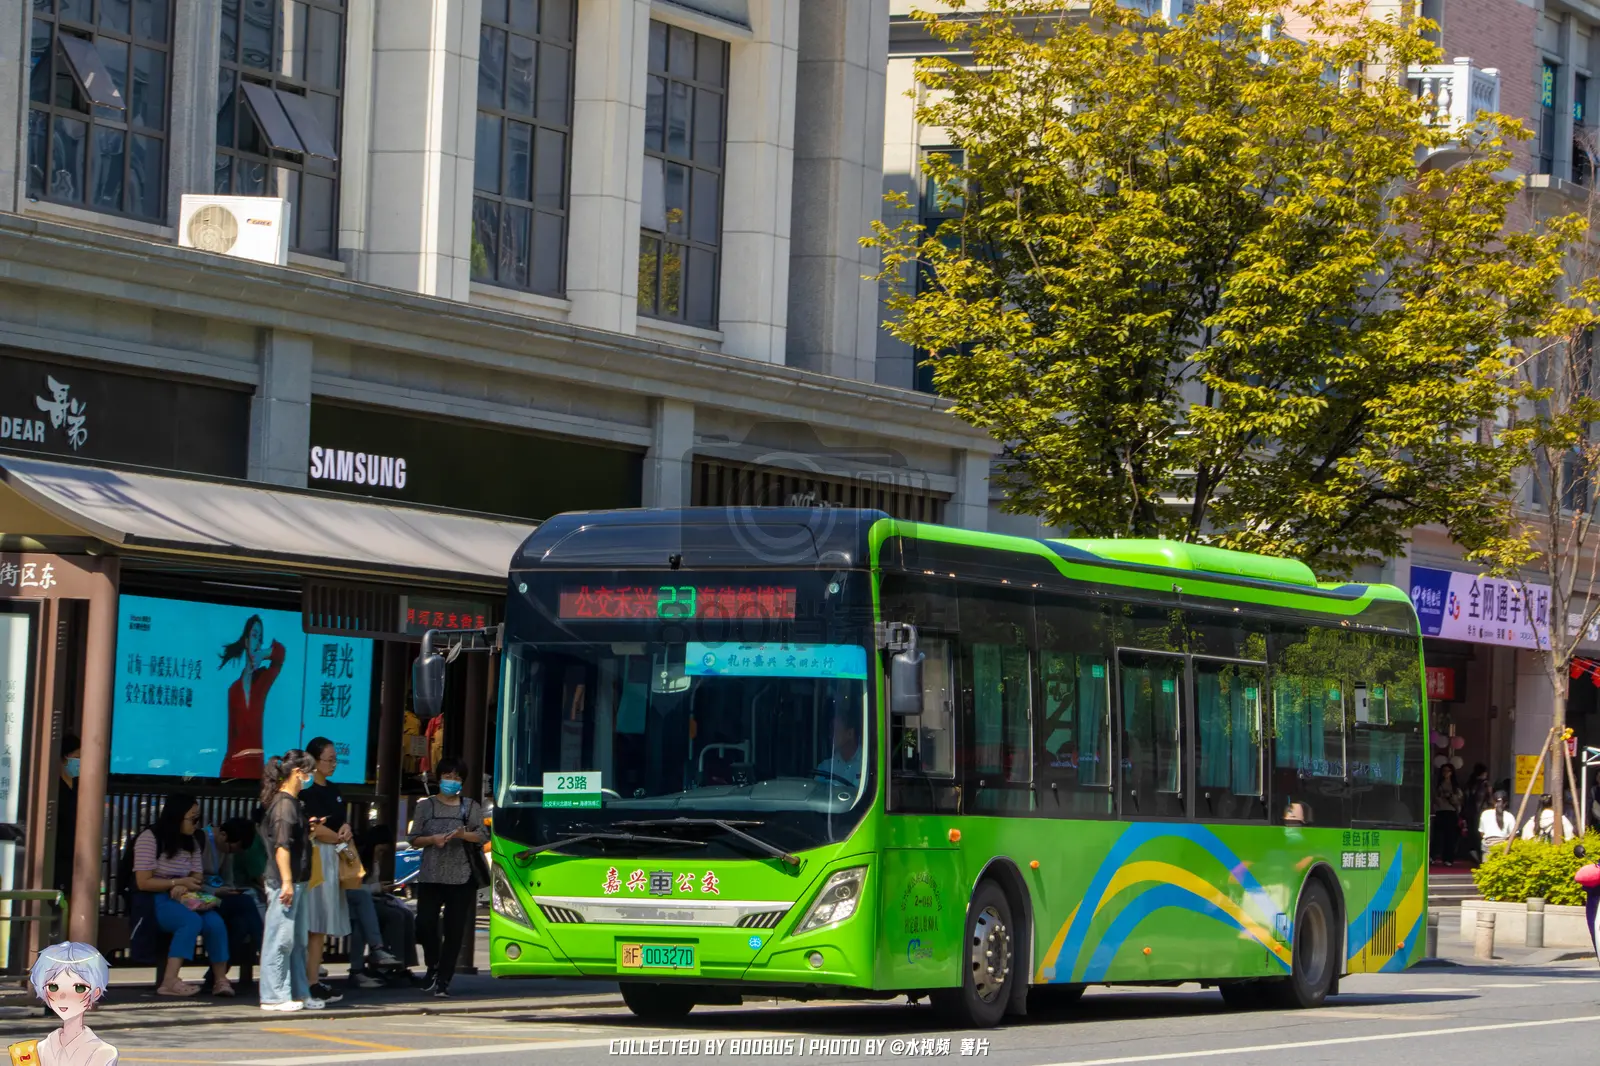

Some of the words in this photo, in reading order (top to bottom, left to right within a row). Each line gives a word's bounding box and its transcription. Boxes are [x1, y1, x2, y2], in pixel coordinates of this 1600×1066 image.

[310, 445, 408, 489] SAMSUNG
[657, 585, 697, 617] 23
[557, 775, 587, 790] 23路
[1342, 831, 1380, 847] 绿色环保
[1342, 852, 1380, 868] 新能源
